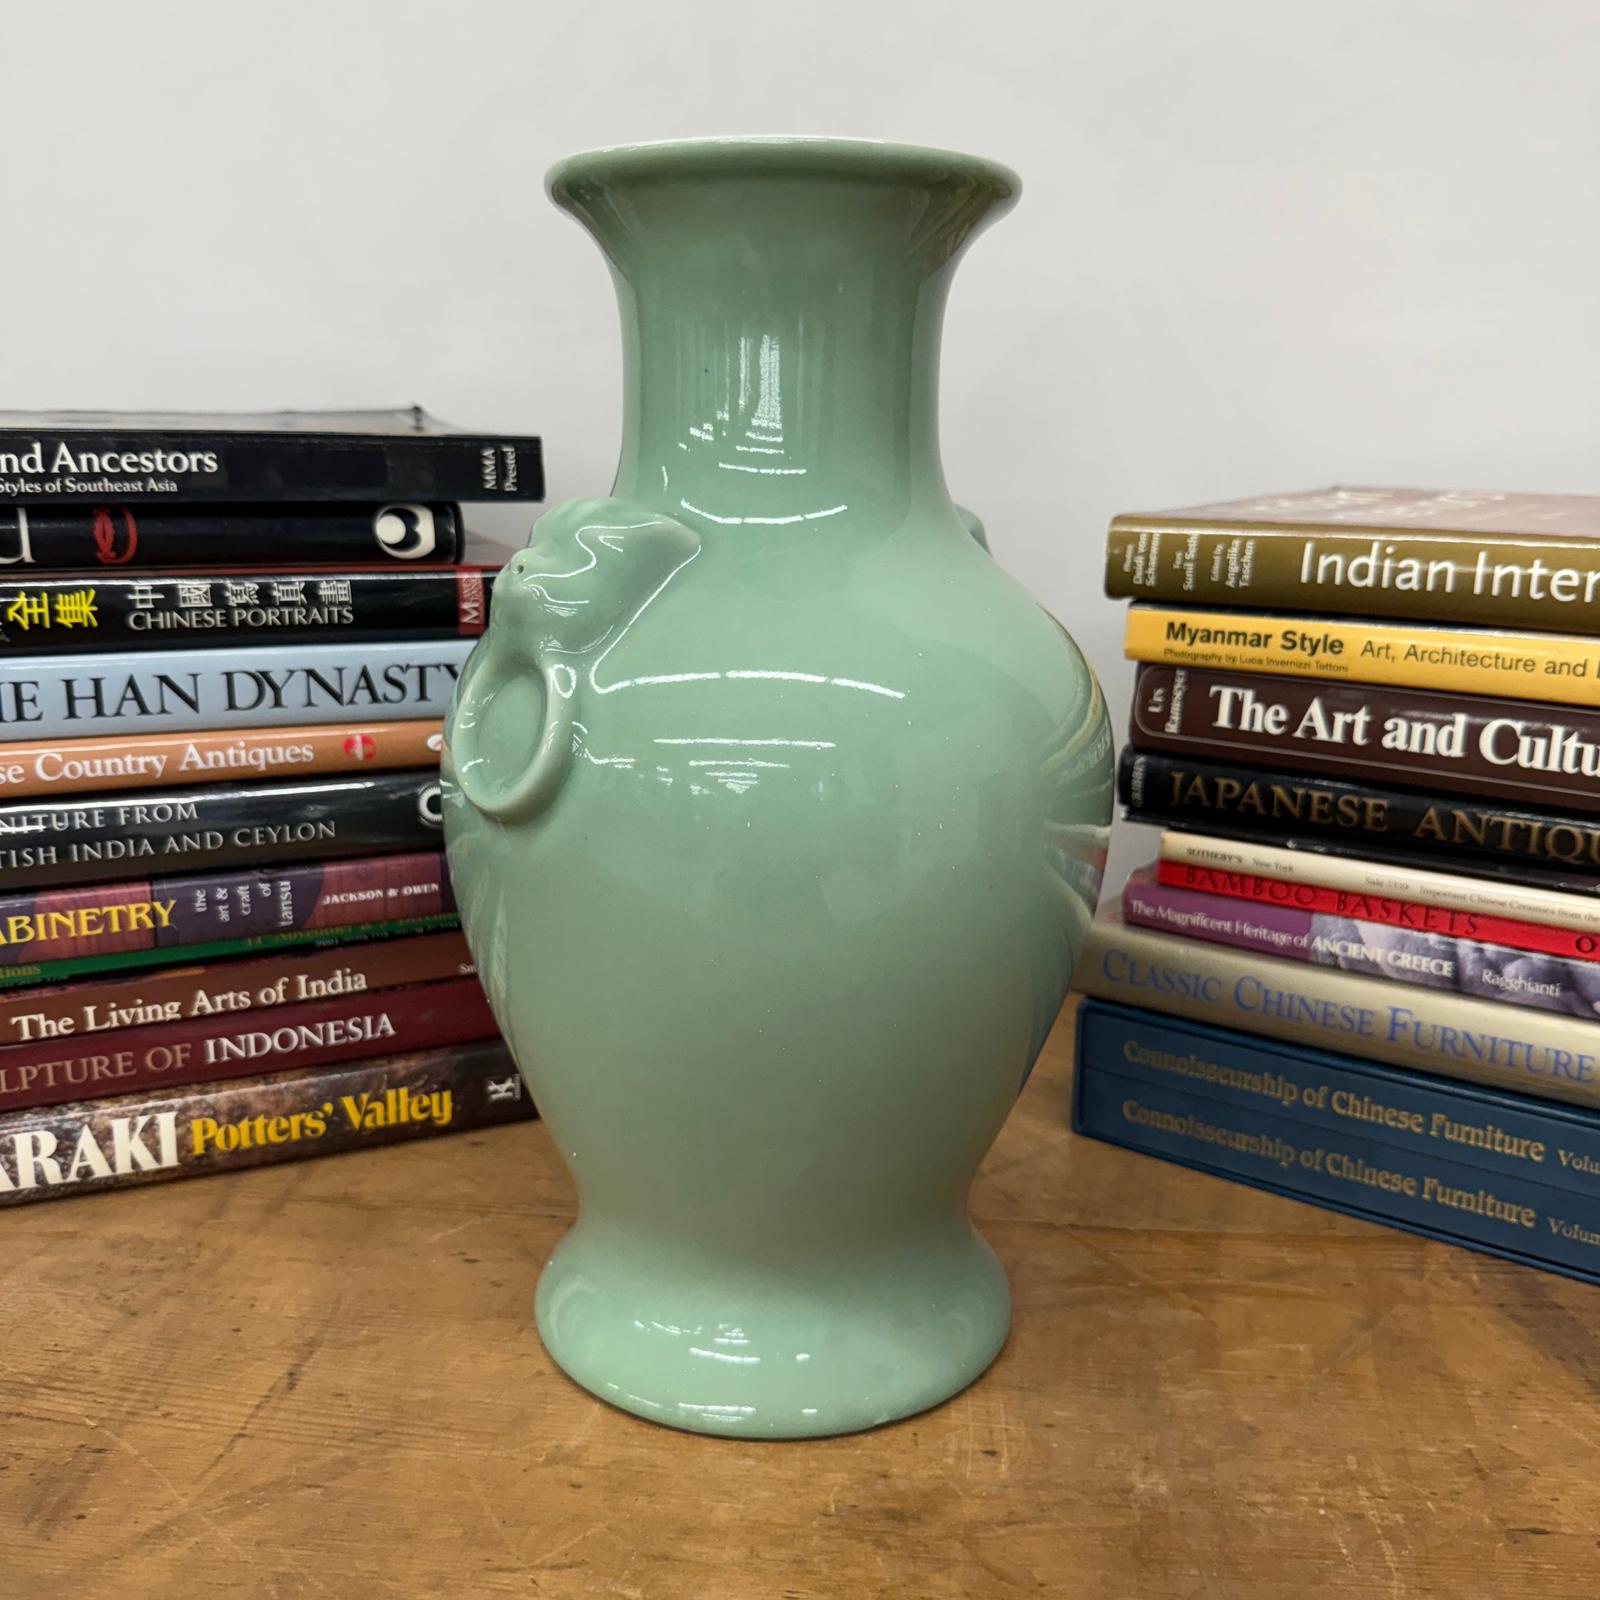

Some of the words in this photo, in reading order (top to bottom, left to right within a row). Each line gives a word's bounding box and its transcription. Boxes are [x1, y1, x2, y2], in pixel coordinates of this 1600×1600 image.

[52, 441, 218, 473] Ancestors
[481, 446, 498, 490] MMA
[501, 444, 518, 492] Prestel
[45, 477, 62, 493] of
[66, 476, 143, 493] Southeast
[146, 477, 178, 492] Asia
[1182, 561, 1195, 591] Sunil
[1225, 539, 1241, 588] Angelika
[1239, 540, 1255, 588] Taschen
[1301, 540, 1455, 593] Indian
[1473, 551, 1600, 603] Inter
[8, 588, 99, 631] 全集
[129, 608, 227, 631] CHINESE
[234, 606, 354, 628] PORTRAITS
[1163, 648, 1222, 664] Photography
[1225, 654, 1237, 664] by
[1240, 654, 1264, 666] Luca
[1266, 656, 1312, 670] Invernizzi
[1165, 620, 1272, 649] Myanmar
[1280, 630, 1345, 657] Style
[1360, 639, 1396, 663] Art,
[1404, 643, 1536, 673] Architecture
[1544, 658, 1588, 678] and
[61, 672, 203, 720] HAN
[1148, 687, 1166, 713] Urs
[1209, 685, 1291, 736] The
[1291, 695, 1373, 747] Art
[1381, 712, 1468, 758] and
[35, 752, 168, 782] Country
[179, 741, 315, 772] Antiques
[118, 803, 199, 827] FROM
[1170, 771, 1390, 833] JAPANESE
[71, 838, 156, 863] INDIA
[165, 831, 224, 854] AND
[234, 820, 336, 848] CEYLON
[194, 888, 208, 912] the
[215, 887, 229, 900] &
[236, 884, 251, 916] craft
[258, 881, 272, 898] of
[322, 889, 383, 905] JACKSON
[387, 887, 399, 898] &
[402, 882, 439, 896] OWEN
[1185, 864, 1316, 906] BAMBOO
[217, 904, 230, 922] art
[1131, 900, 1155, 918] The
[1157, 904, 1233, 934] Magnificent
[1235, 920, 1293, 947] Heritage
[1293, 931, 1311, 948] of
[1312, 934, 1385, 963] ANCIENT
[1387, 949, 1454, 978] GREECE
[1482, 968, 1561, 998] Ragghianti
[10, 1012, 75, 1042] The
[82, 999, 182, 1032] Living
[190, 989, 251, 1018] Arts
[258, 976, 291, 1006] of
[296, 968, 368, 1000] India
[145, 1042, 193, 1072] OF
[204, 1012, 397, 1065] INDONESIA
[341, 1086, 453, 1132] Valley
[1122, 1039, 1299, 1107] Connoisseurship
[1302, 1085, 1329, 1110] of
[1331, 1090, 1424, 1134] Chinese
[1429, 1111, 1546, 1162] Furniture
[1121, 1099, 1296, 1169] Connoisseurship
[1300, 1147, 1325, 1171] of
[1326, 1152, 1417, 1197] Chinese
[1422, 1175, 1537, 1229] Furniture
